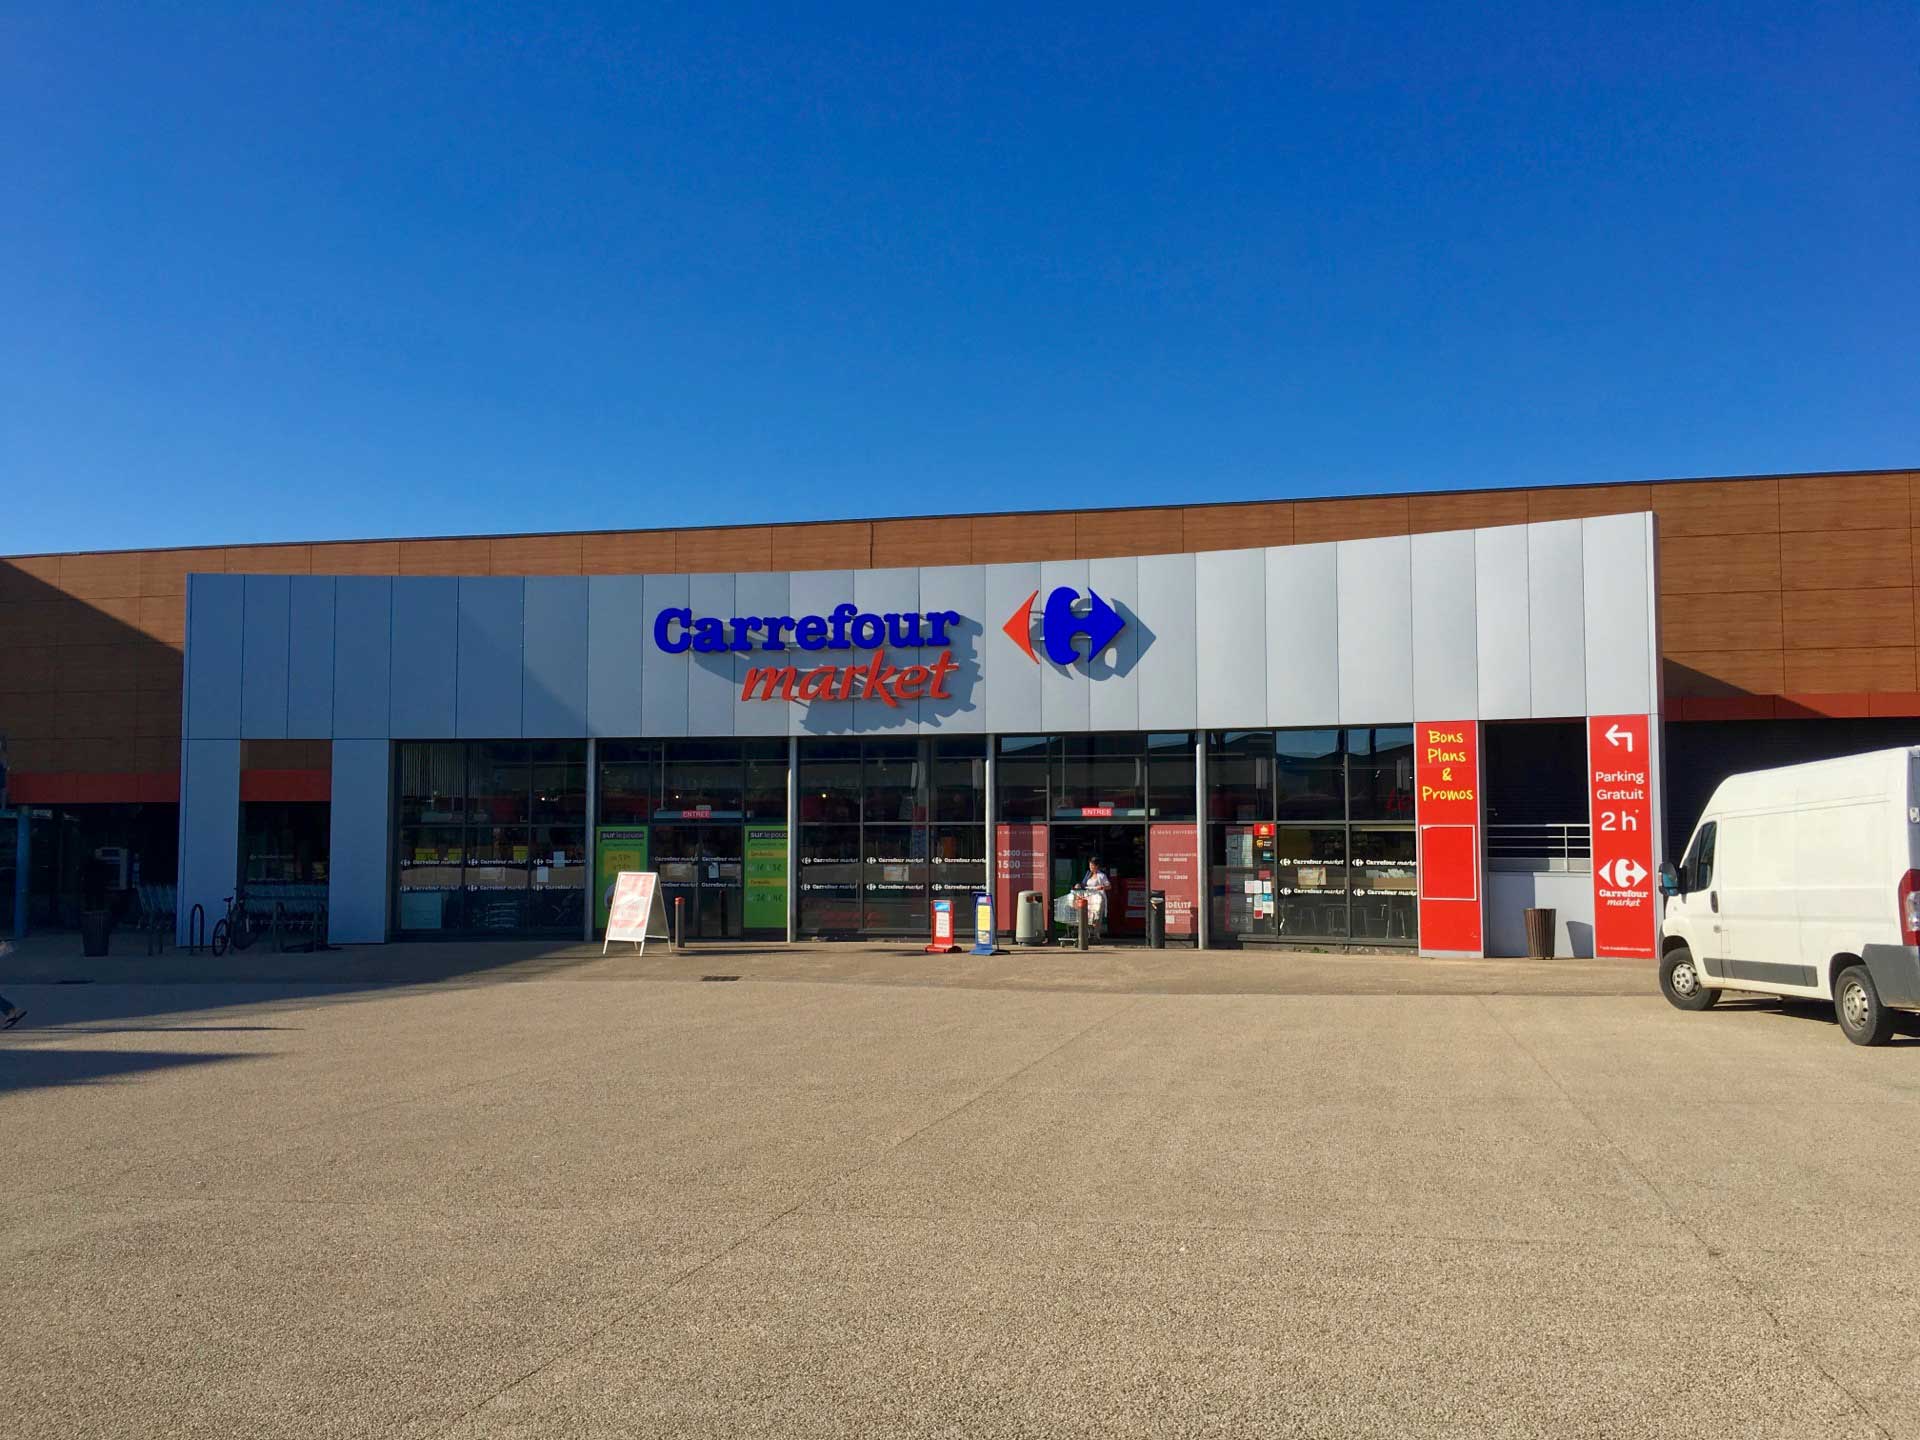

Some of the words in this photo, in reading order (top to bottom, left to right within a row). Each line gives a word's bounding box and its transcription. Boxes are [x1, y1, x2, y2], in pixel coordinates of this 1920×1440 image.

[653, 603, 960, 654] Carrefour
[741, 648, 959, 708] market
[1428, 730, 1464, 744] Bons
[1427, 748, 1467, 764] Plans
[1442, 767, 1453, 782] &
[1595, 771, 1645, 784] Parking
[1422, 785, 1474, 801] Promos
[1596, 788, 1644, 800] Gratuit
[1600, 812, 1617, 831] 2
[1599, 889, 1649, 898] Carrefour
[1606, 899, 1642, 907] market
